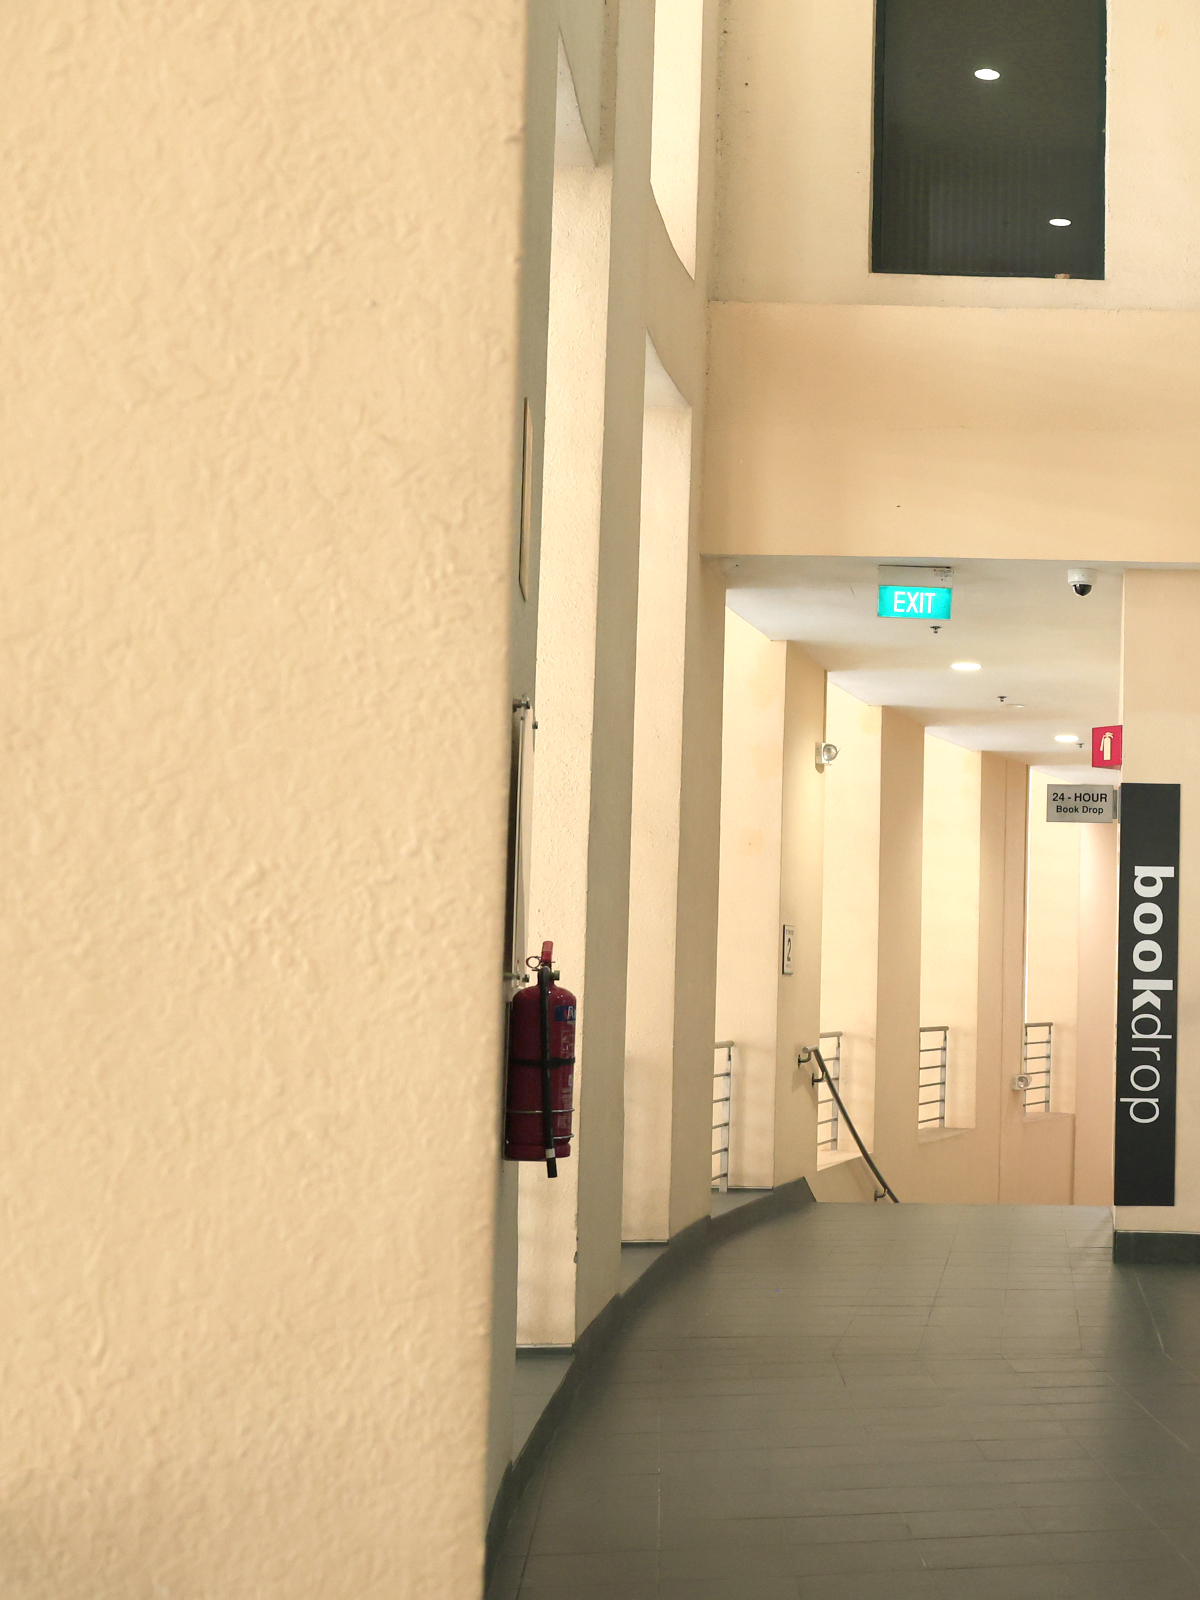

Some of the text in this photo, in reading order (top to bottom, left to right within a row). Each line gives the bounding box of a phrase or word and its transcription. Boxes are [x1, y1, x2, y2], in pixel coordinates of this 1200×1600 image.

[893, 591, 936, 613] EXIT
[1052, 792, 1065, 802] 24
[1074, 792, 1108, 803] HOUR
[1056, 805, 1104, 816] Book Drop
[786, 937, 792, 962] 2
[1119, 865, 1175, 1124] bookdrop
